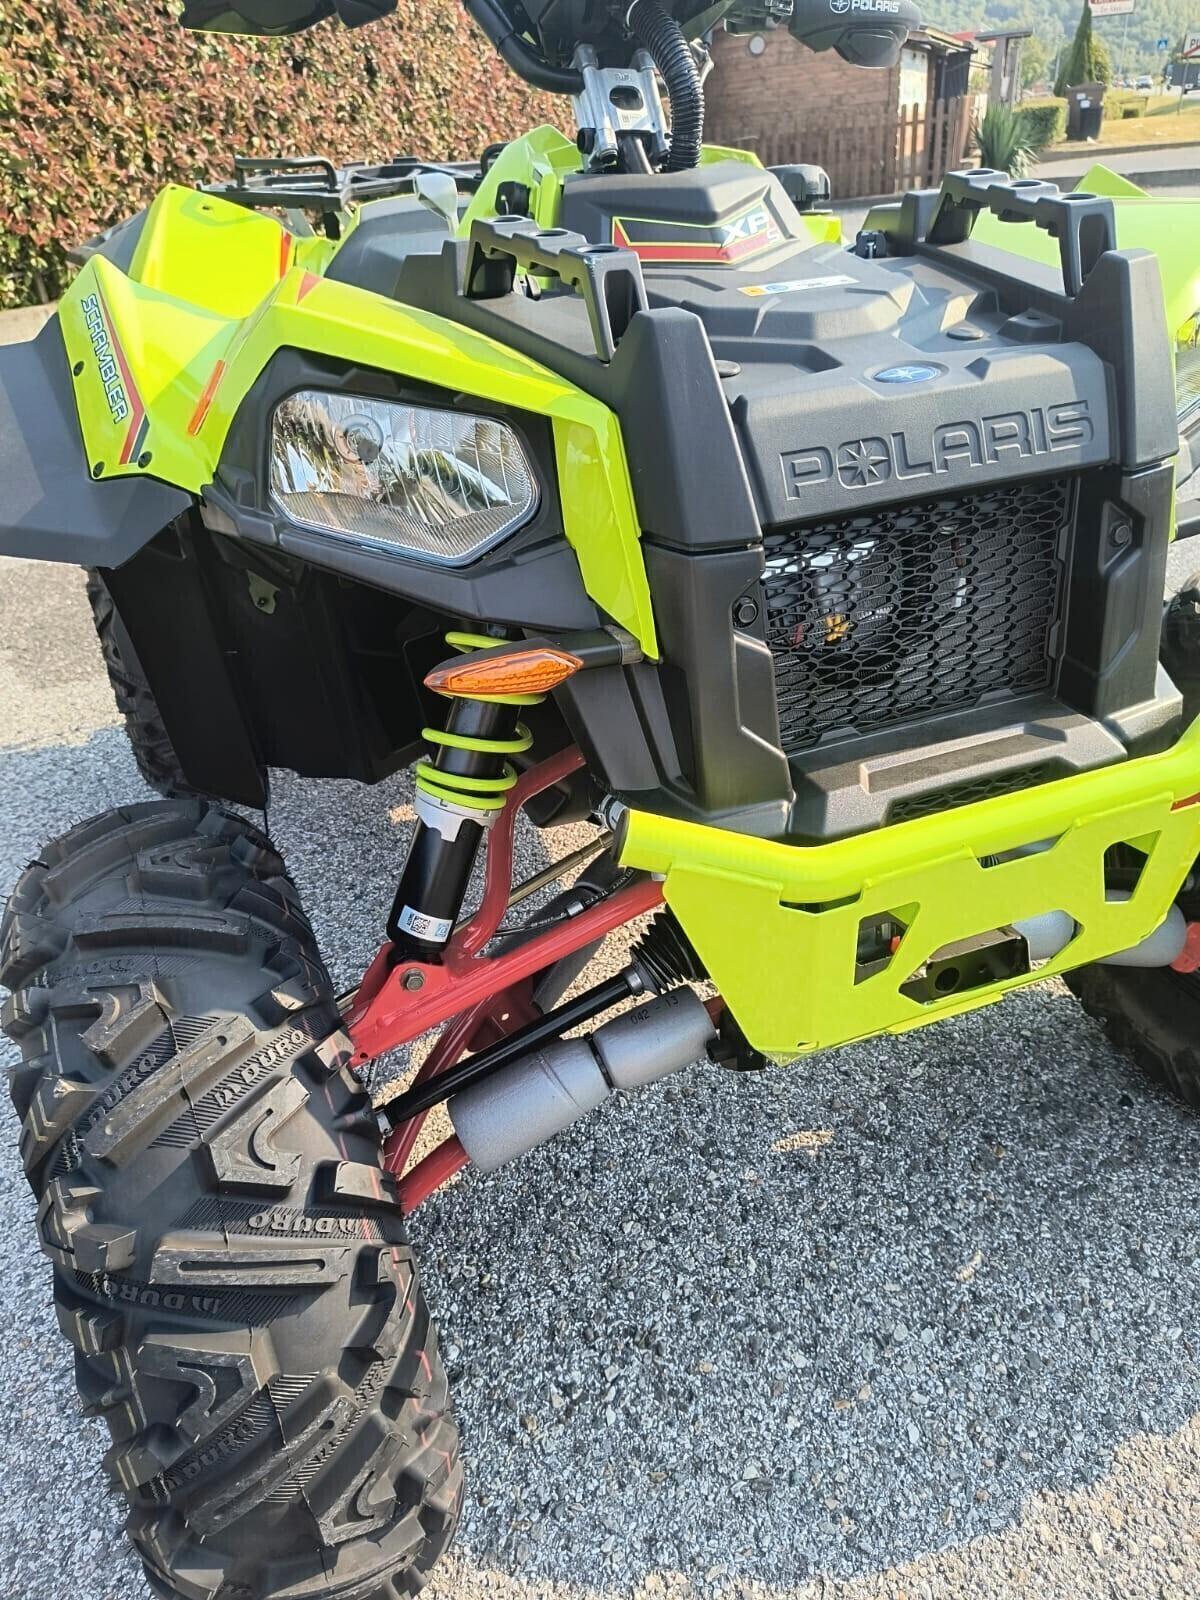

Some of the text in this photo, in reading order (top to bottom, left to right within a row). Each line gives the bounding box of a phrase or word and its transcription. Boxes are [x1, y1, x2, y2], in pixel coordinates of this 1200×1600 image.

[852, 0, 900, 13] POLARIS
[720, 211, 769, 248] XP
[81, 293, 128, 424] SCRAMBLER
[780, 400, 1094, 500] POLARIS
[240, 1030, 305, 1083] DURO
[249, 1211, 335, 1233] DURO
